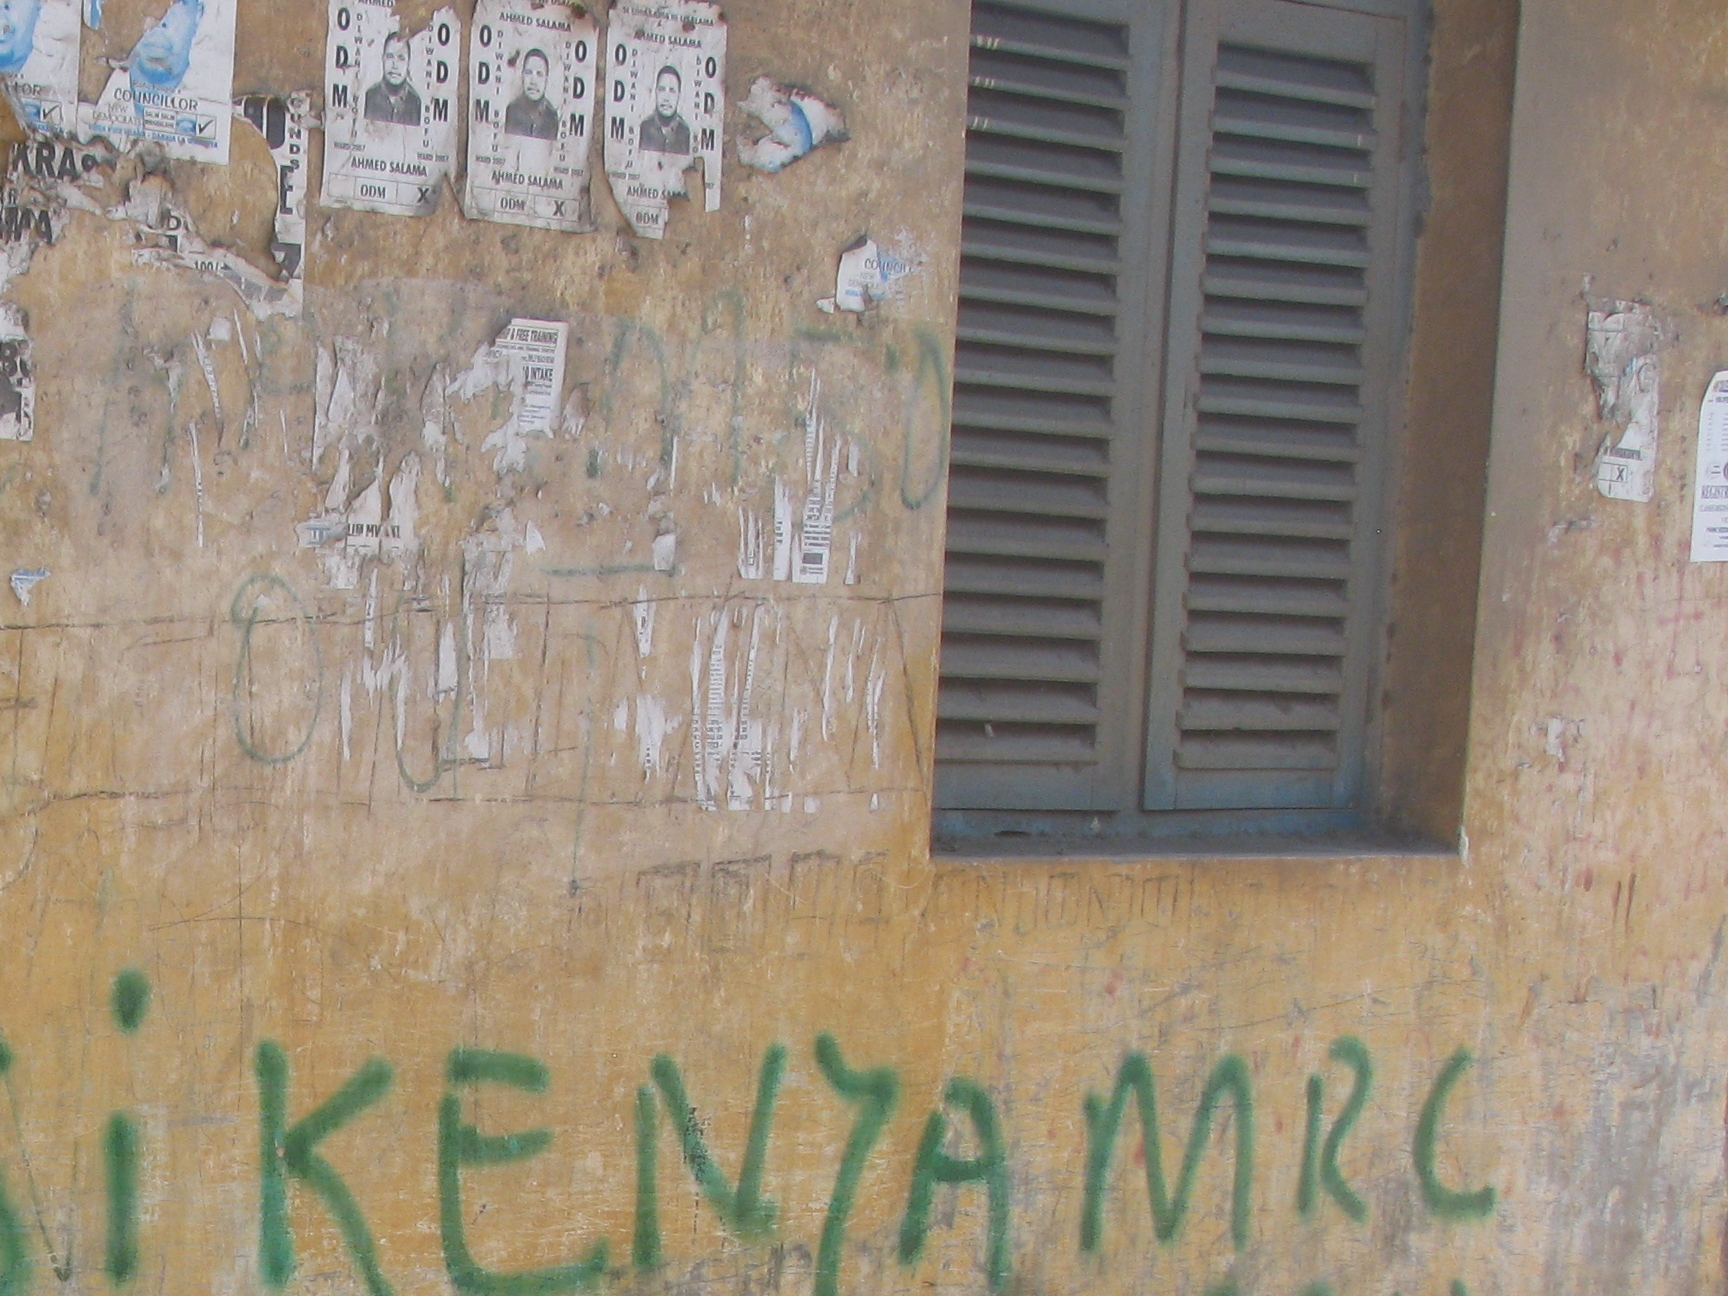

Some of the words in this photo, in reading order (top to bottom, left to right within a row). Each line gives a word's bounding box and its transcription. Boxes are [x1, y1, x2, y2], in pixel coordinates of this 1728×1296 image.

[113, 87, 199, 112] COUNCILLOR
[350, 155, 387, 172] AHMED
[389, 160, 428, 178] SALAMA
[491, 169, 526, 186] AHMED
[527, 173, 564, 190] SALAMA
[360, 184, 387, 200] ODM
[625, 185, 659, 200] AHMED
[499, 196, 526, 211] ODM
[634, 211, 659, 225] ODM
[1078, 1034, 1498, 1254] MRC
